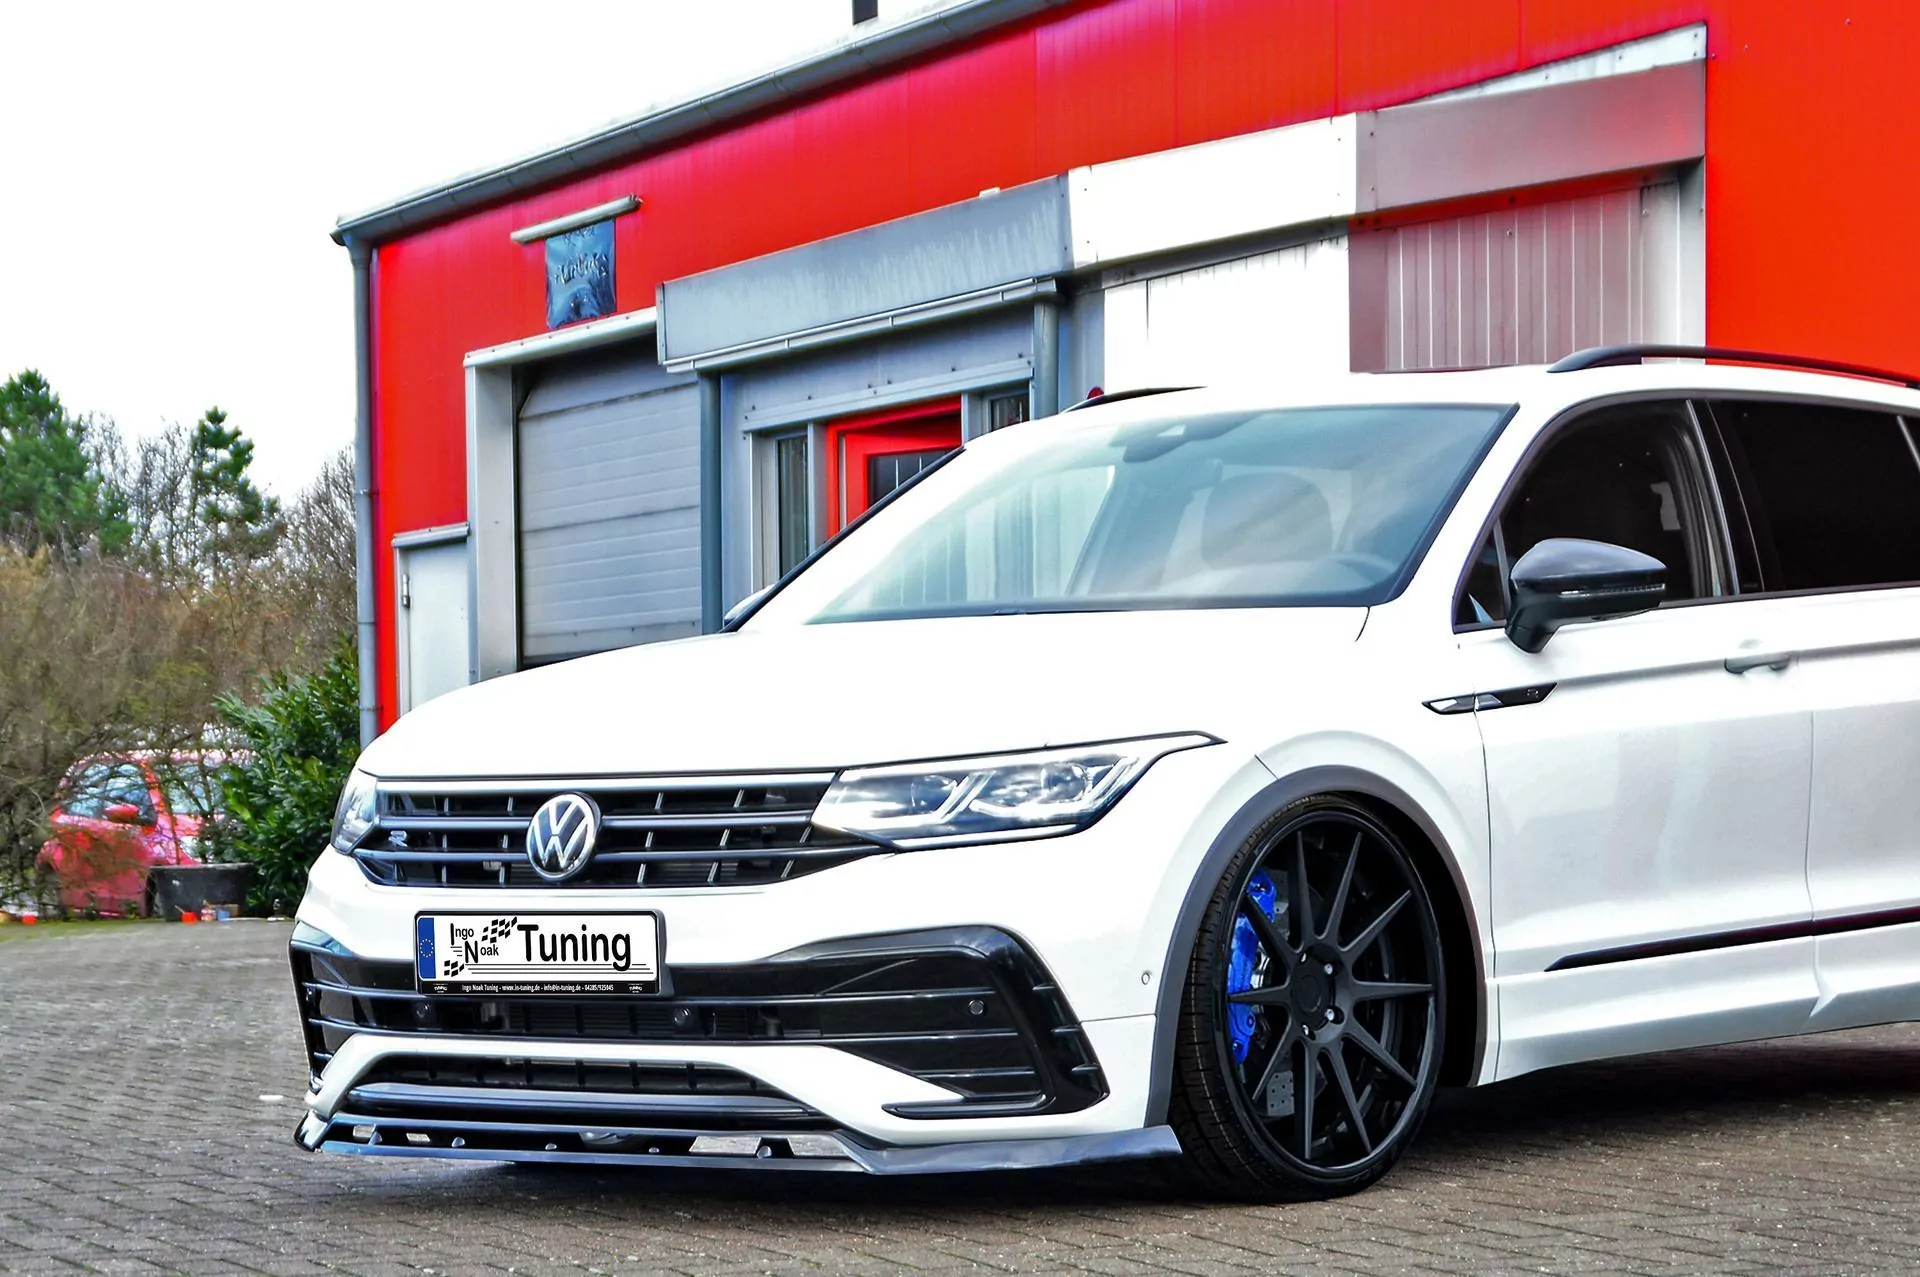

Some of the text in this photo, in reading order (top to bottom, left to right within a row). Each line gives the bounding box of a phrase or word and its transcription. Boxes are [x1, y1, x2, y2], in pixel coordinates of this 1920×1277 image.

[388, 830, 408, 847] R
[529, 795, 598, 873] VW
[450, 922, 475, 945] Ingo
[464, 940, 499, 964] Noak
[516, 923, 632, 972] Tuning
